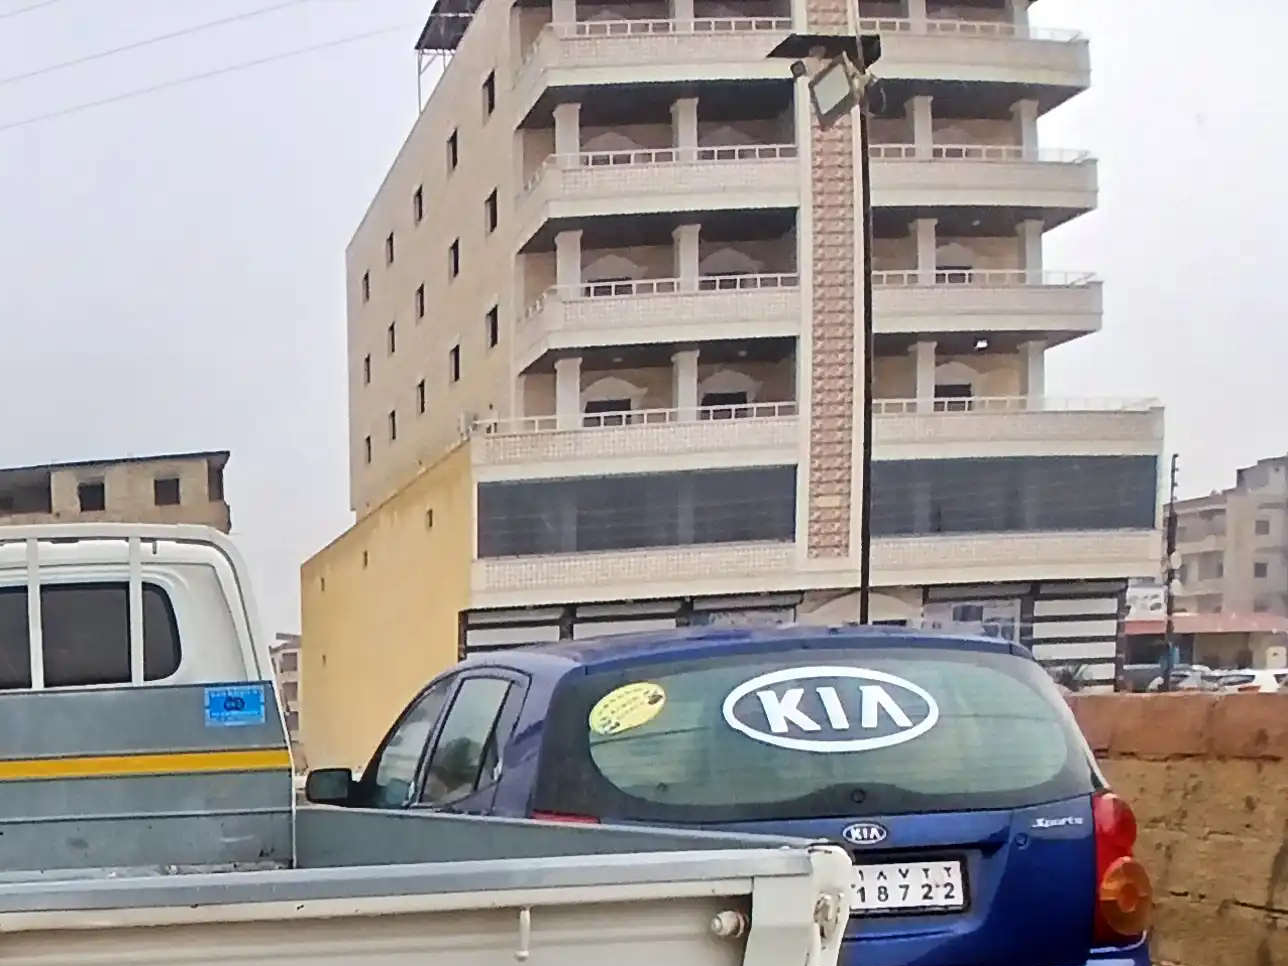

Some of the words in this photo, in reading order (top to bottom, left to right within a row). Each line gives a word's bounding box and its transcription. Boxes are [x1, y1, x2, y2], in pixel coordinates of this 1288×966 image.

[756, 685, 914, 733] KIA
[851, 827, 881, 840] KIA
[856, 882, 955, 903] 18722
